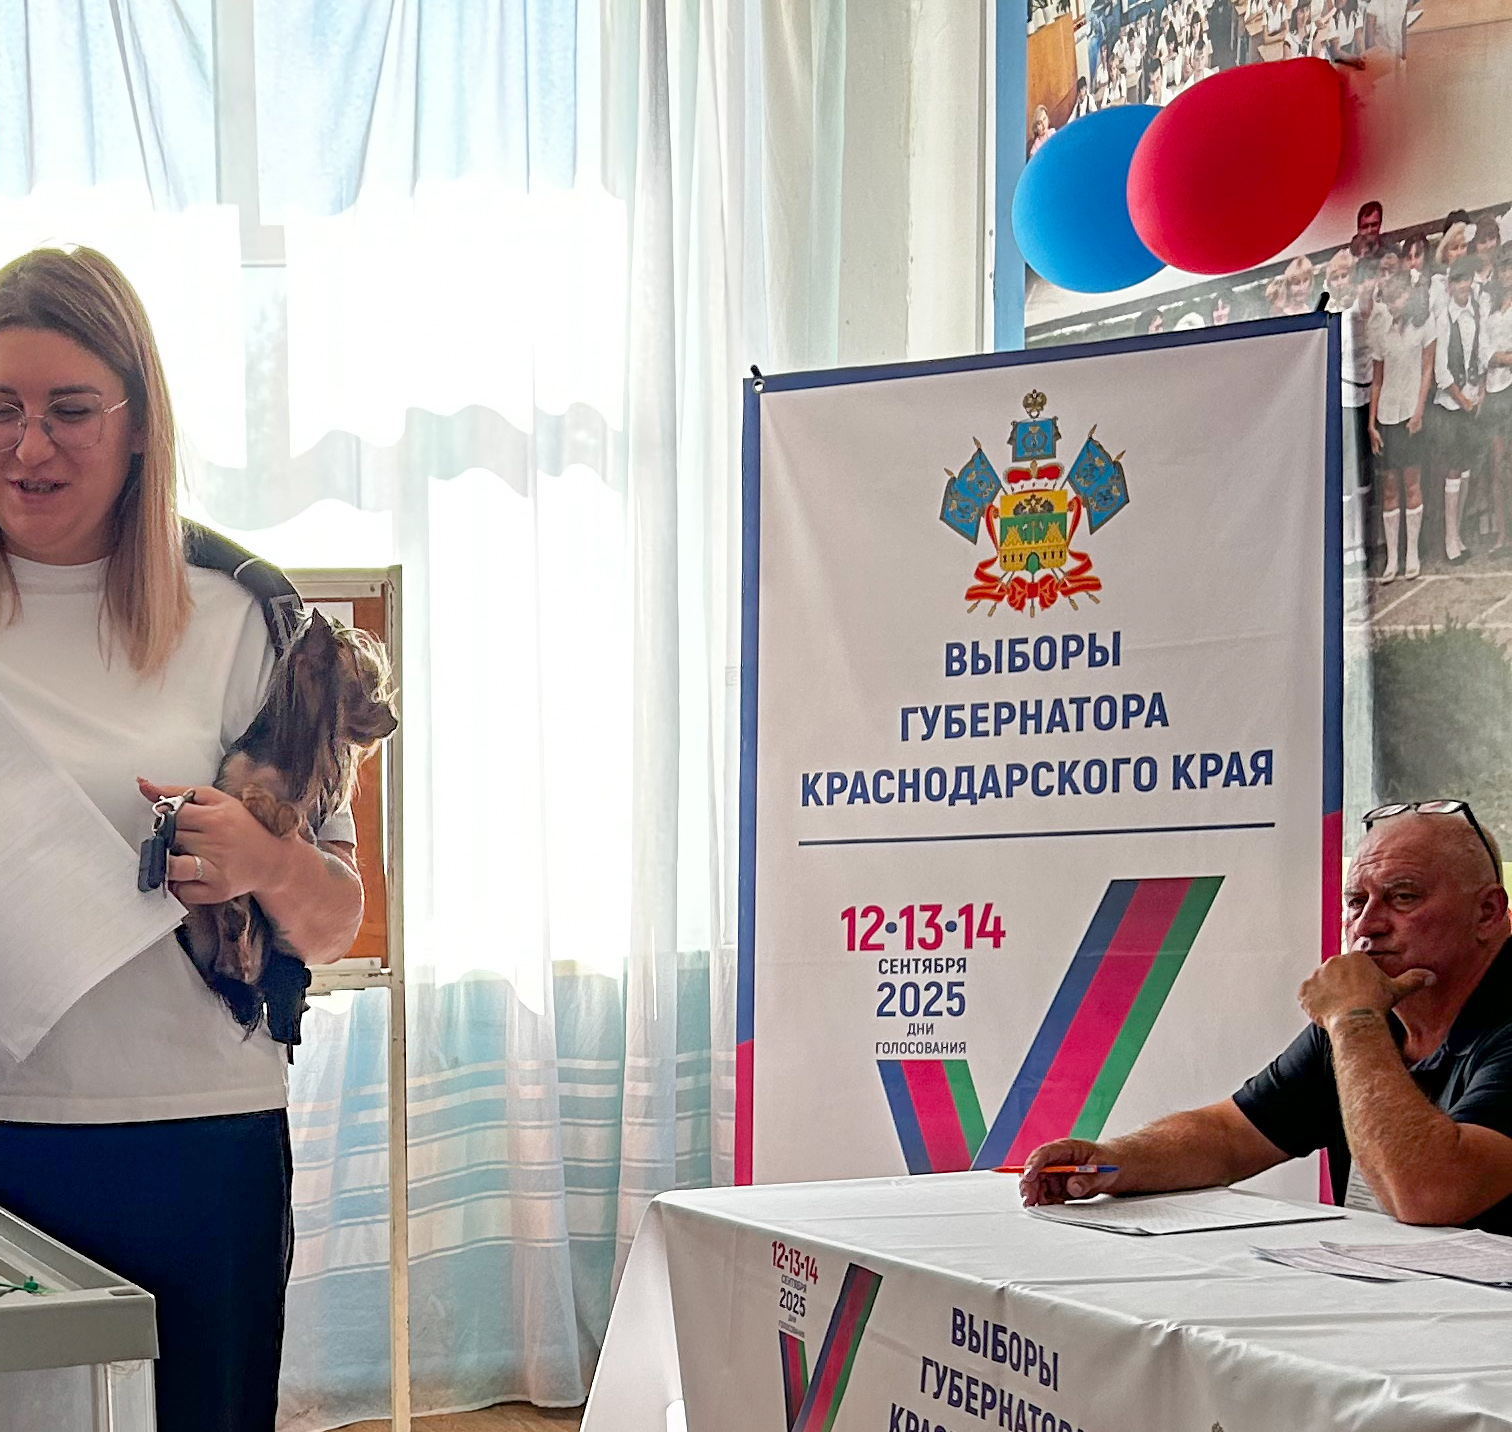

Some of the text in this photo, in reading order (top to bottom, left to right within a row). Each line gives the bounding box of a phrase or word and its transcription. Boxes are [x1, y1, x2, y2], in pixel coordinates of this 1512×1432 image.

[944, 630, 1122, 678] ВЫБОРЫ
[899, 691, 1170, 742] ГУБЕРНАТОРА
[800, 748, 1275, 808] КРАСНОДАРСКОГО КРАЯ
[878, 957, 967, 975] СЕНТЯБРЯ
[875, 981, 966, 1017] 2025
[875, 1041, 967, 1055] ГОЛОСОВАНИЯ
[906, 1023, 935, 1037] ДНИ
[779, 1287, 806, 1317] 2025
[951, 1307, 1060, 1392] ВЫБОРЫ
